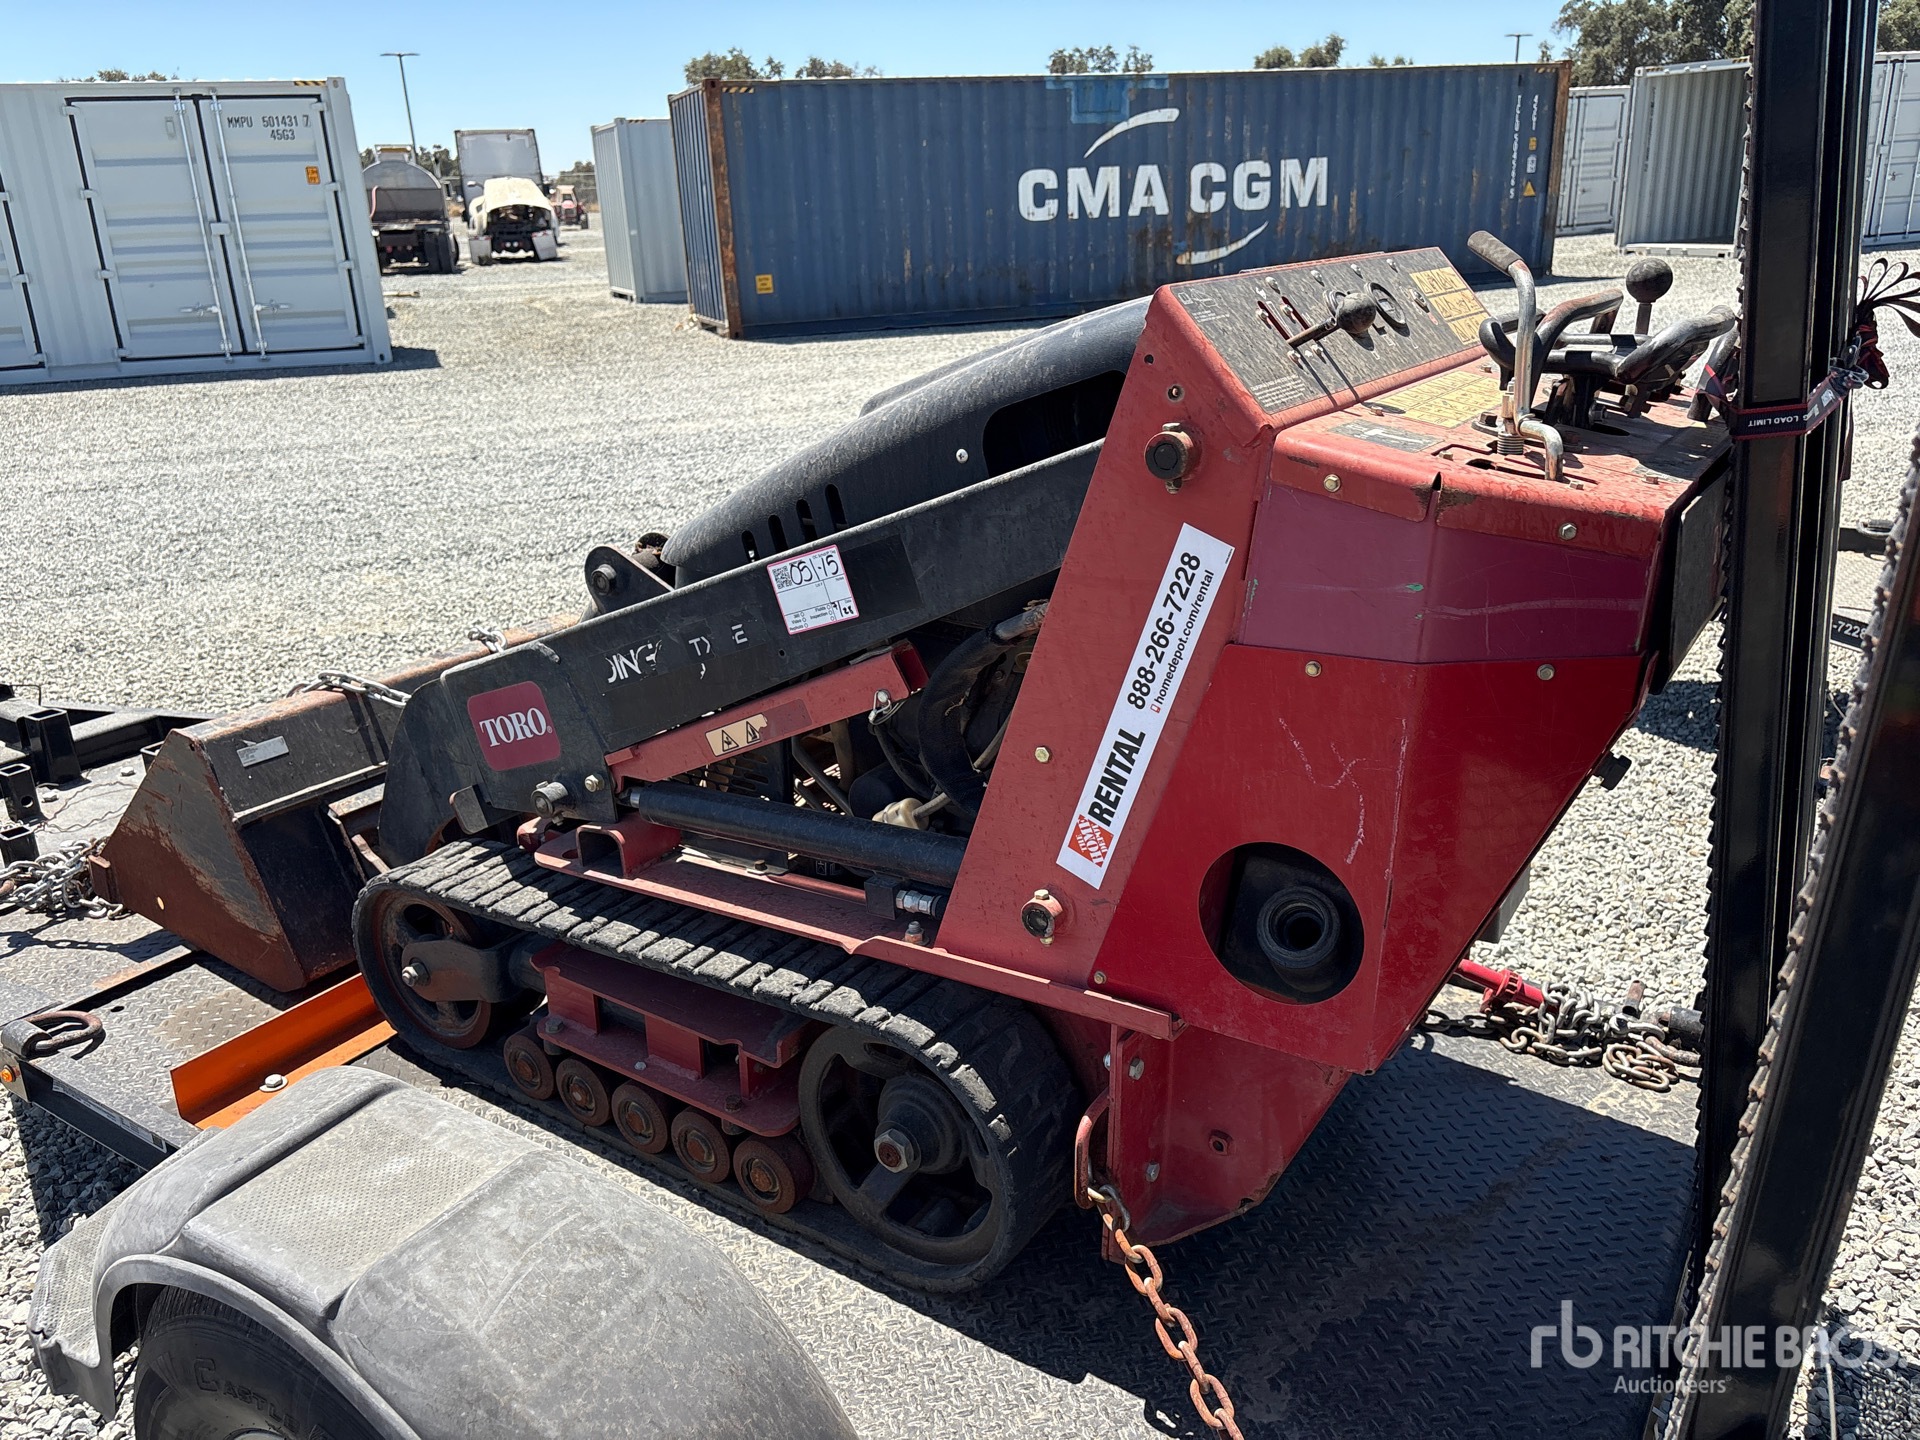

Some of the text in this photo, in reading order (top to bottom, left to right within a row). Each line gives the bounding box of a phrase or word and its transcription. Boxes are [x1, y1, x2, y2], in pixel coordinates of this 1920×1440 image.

[227, 116, 253, 128] MMPU
[262, 115, 299, 128] 501431
[270, 129, 296, 141] 45G3
[1018, 156, 1328, 222] CMA CGM
[1748, 415, 1799, 427] LOAD LIMIT
[1127, 552, 1200, 710] 888-266-7228
[1154, 569, 1214, 705] homedepot.com/rental
[479, 707, 547, 748] TORO
[1088, 728, 1146, 827] RENTAL
[1076, 834, 1088, 852] THE
[1078, 817, 1104, 865] HOME
[1091, 824, 1108, 853] DEPOT
